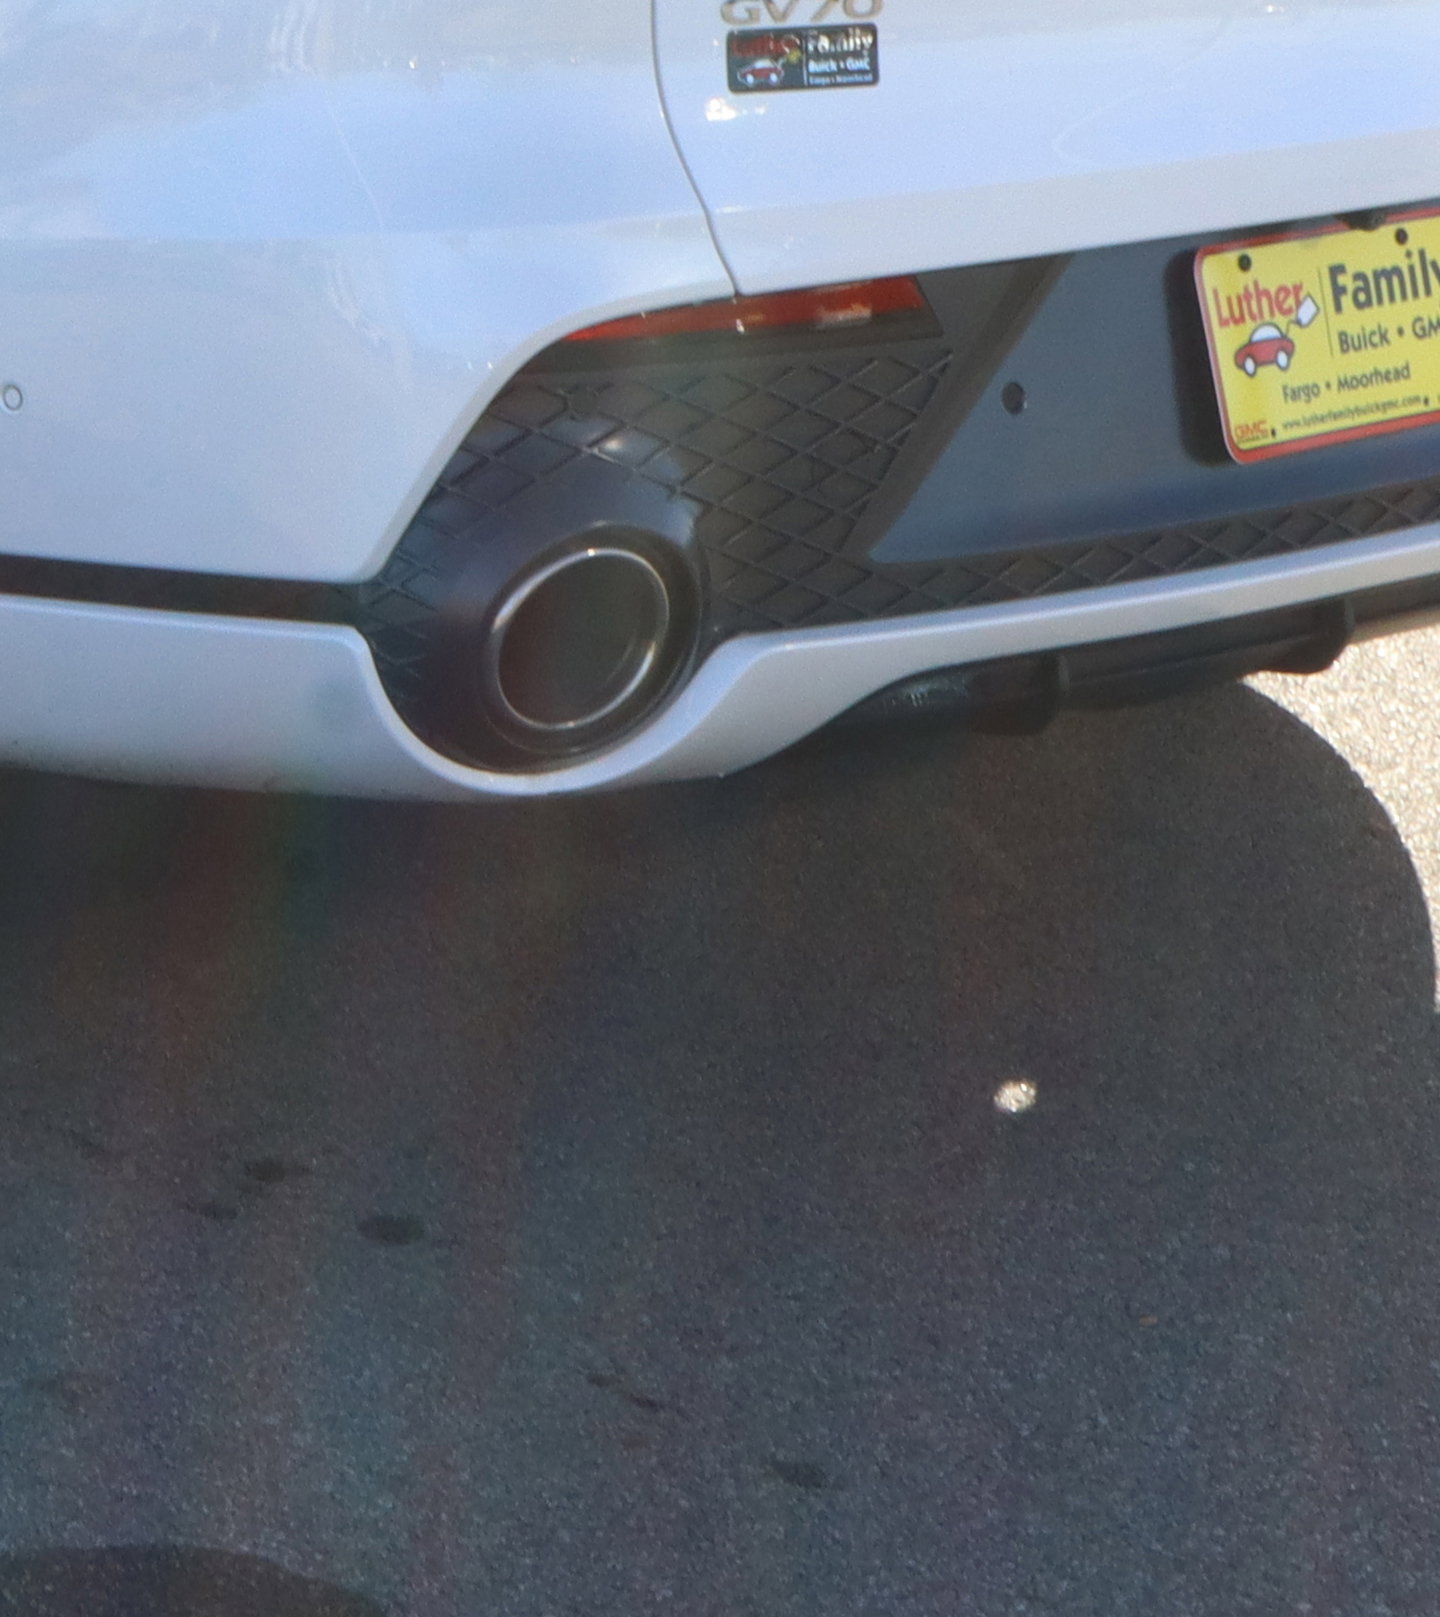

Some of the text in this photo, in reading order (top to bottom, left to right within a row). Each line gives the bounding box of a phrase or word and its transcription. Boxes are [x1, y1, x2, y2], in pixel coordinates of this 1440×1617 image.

[1212, 279, 1305, 328] Luther
[1338, 324, 1391, 355] Buick
[1281, 362, 1411, 404] Fargo Moorhead
